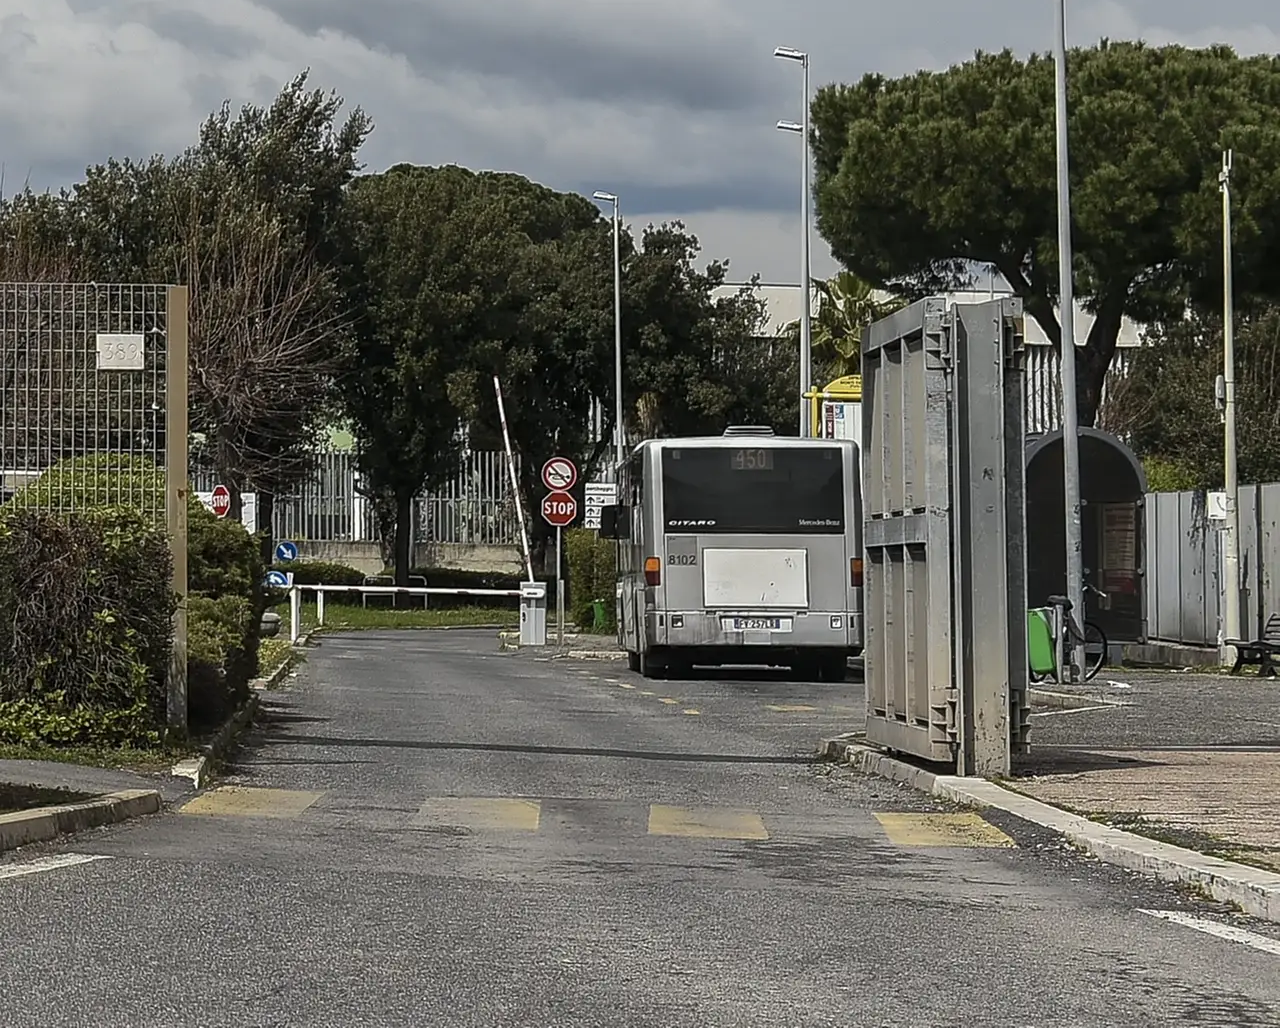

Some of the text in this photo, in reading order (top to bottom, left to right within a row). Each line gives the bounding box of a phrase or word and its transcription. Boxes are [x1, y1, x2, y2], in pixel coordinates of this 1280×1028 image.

[212, 495, 228, 507] STOP
[544, 501, 574, 515] STOP
[668, 554, 697, 565] 8102
